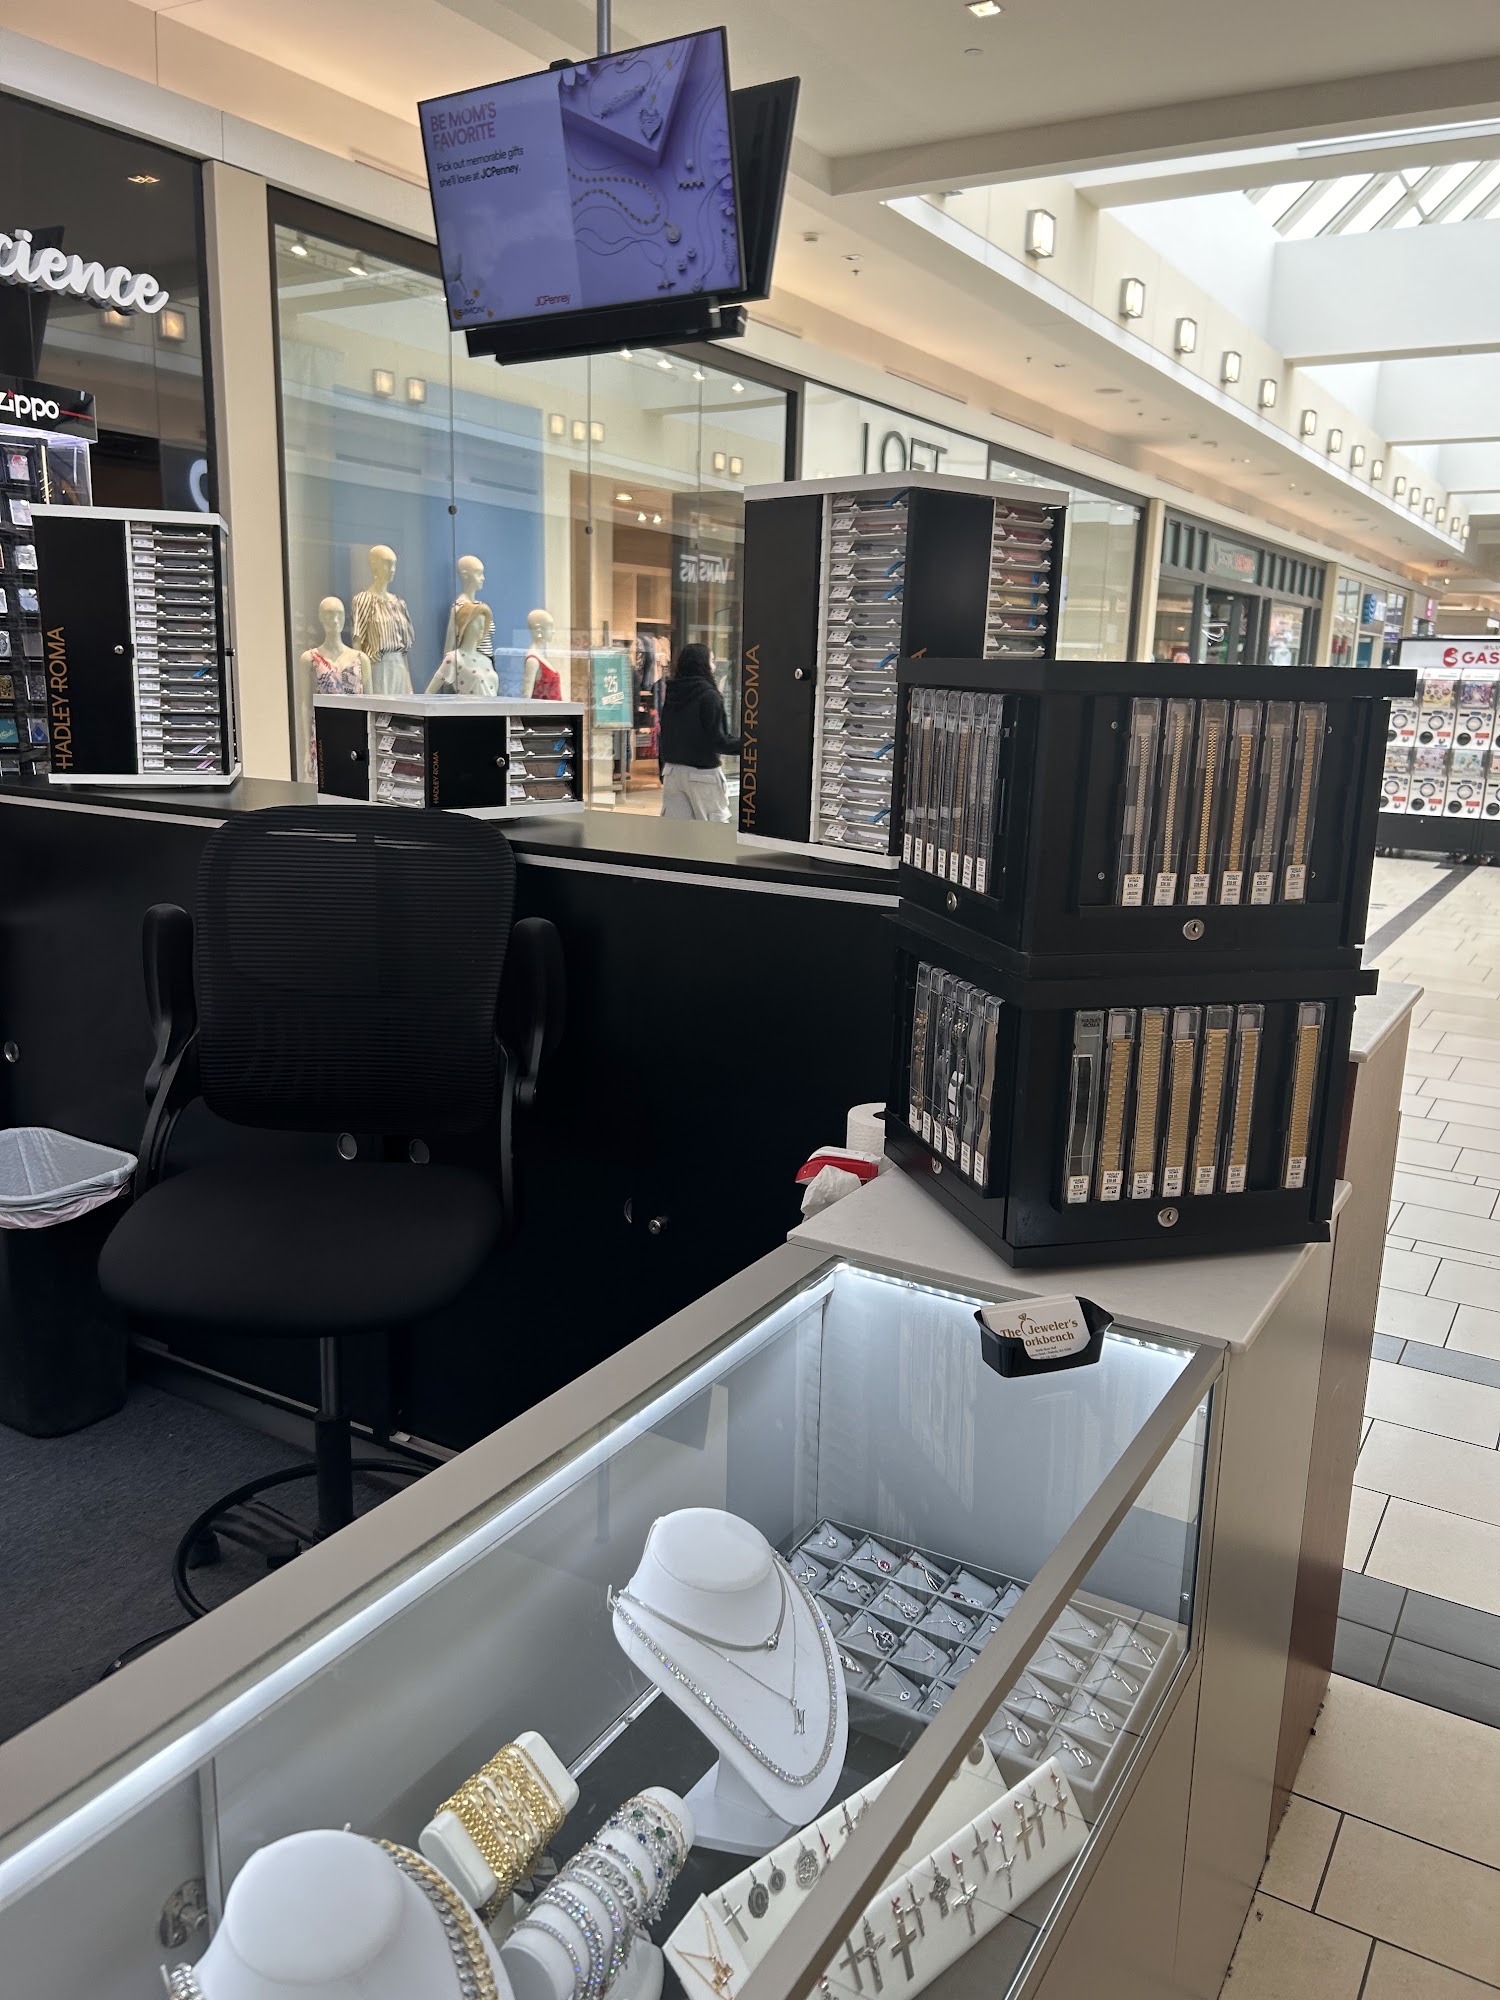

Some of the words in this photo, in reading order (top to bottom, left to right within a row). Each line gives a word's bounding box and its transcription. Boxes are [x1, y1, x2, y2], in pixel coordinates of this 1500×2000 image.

[430, 114, 446, 132] BE
[433, 121, 496, 149] FAVORITE
[466, 150, 507, 166] memorable
[534, 294, 571, 306] JCPenney
[47, 626, 69, 692] ROMA
[744, 644, 760, 729] ROMA
[51, 694, 73, 769] HADLEY
[742, 731, 757, 827] HADLEY
[1000, 1328, 1021, 1338] The
[1028, 1319, 1078, 1334] Jeweler's
[1025, 1332, 1074, 1347] orkbench
